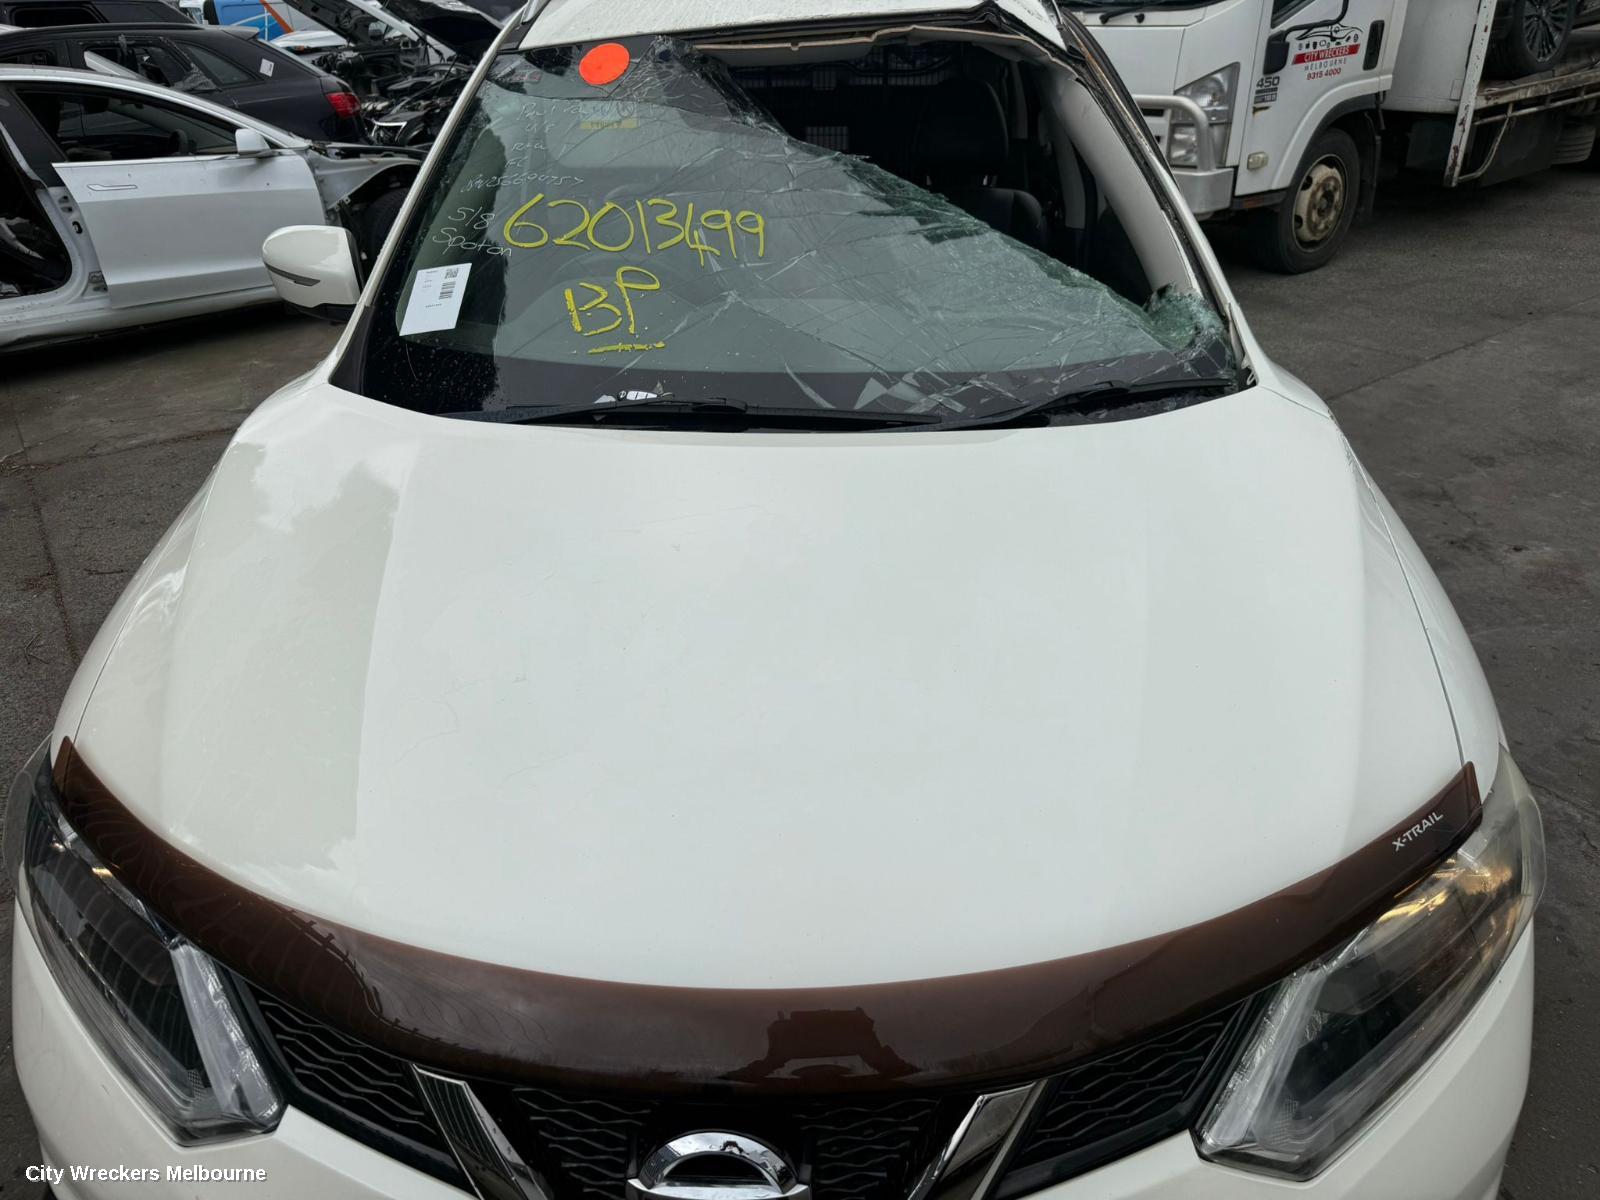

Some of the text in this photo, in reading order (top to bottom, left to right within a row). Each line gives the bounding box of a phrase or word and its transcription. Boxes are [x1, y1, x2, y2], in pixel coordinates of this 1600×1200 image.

[1319, 46, 1350, 60] WRECKERS
[1304, 58, 1347, 71] MELBOURNE
[1323, 67, 1342, 77] 4000
[1256, 76, 1280, 88] 450
[504, 193, 765, 266] 62013499
[564, 265, 661, 337] BP
[1391, 811, 1443, 852] X-TRAIL
